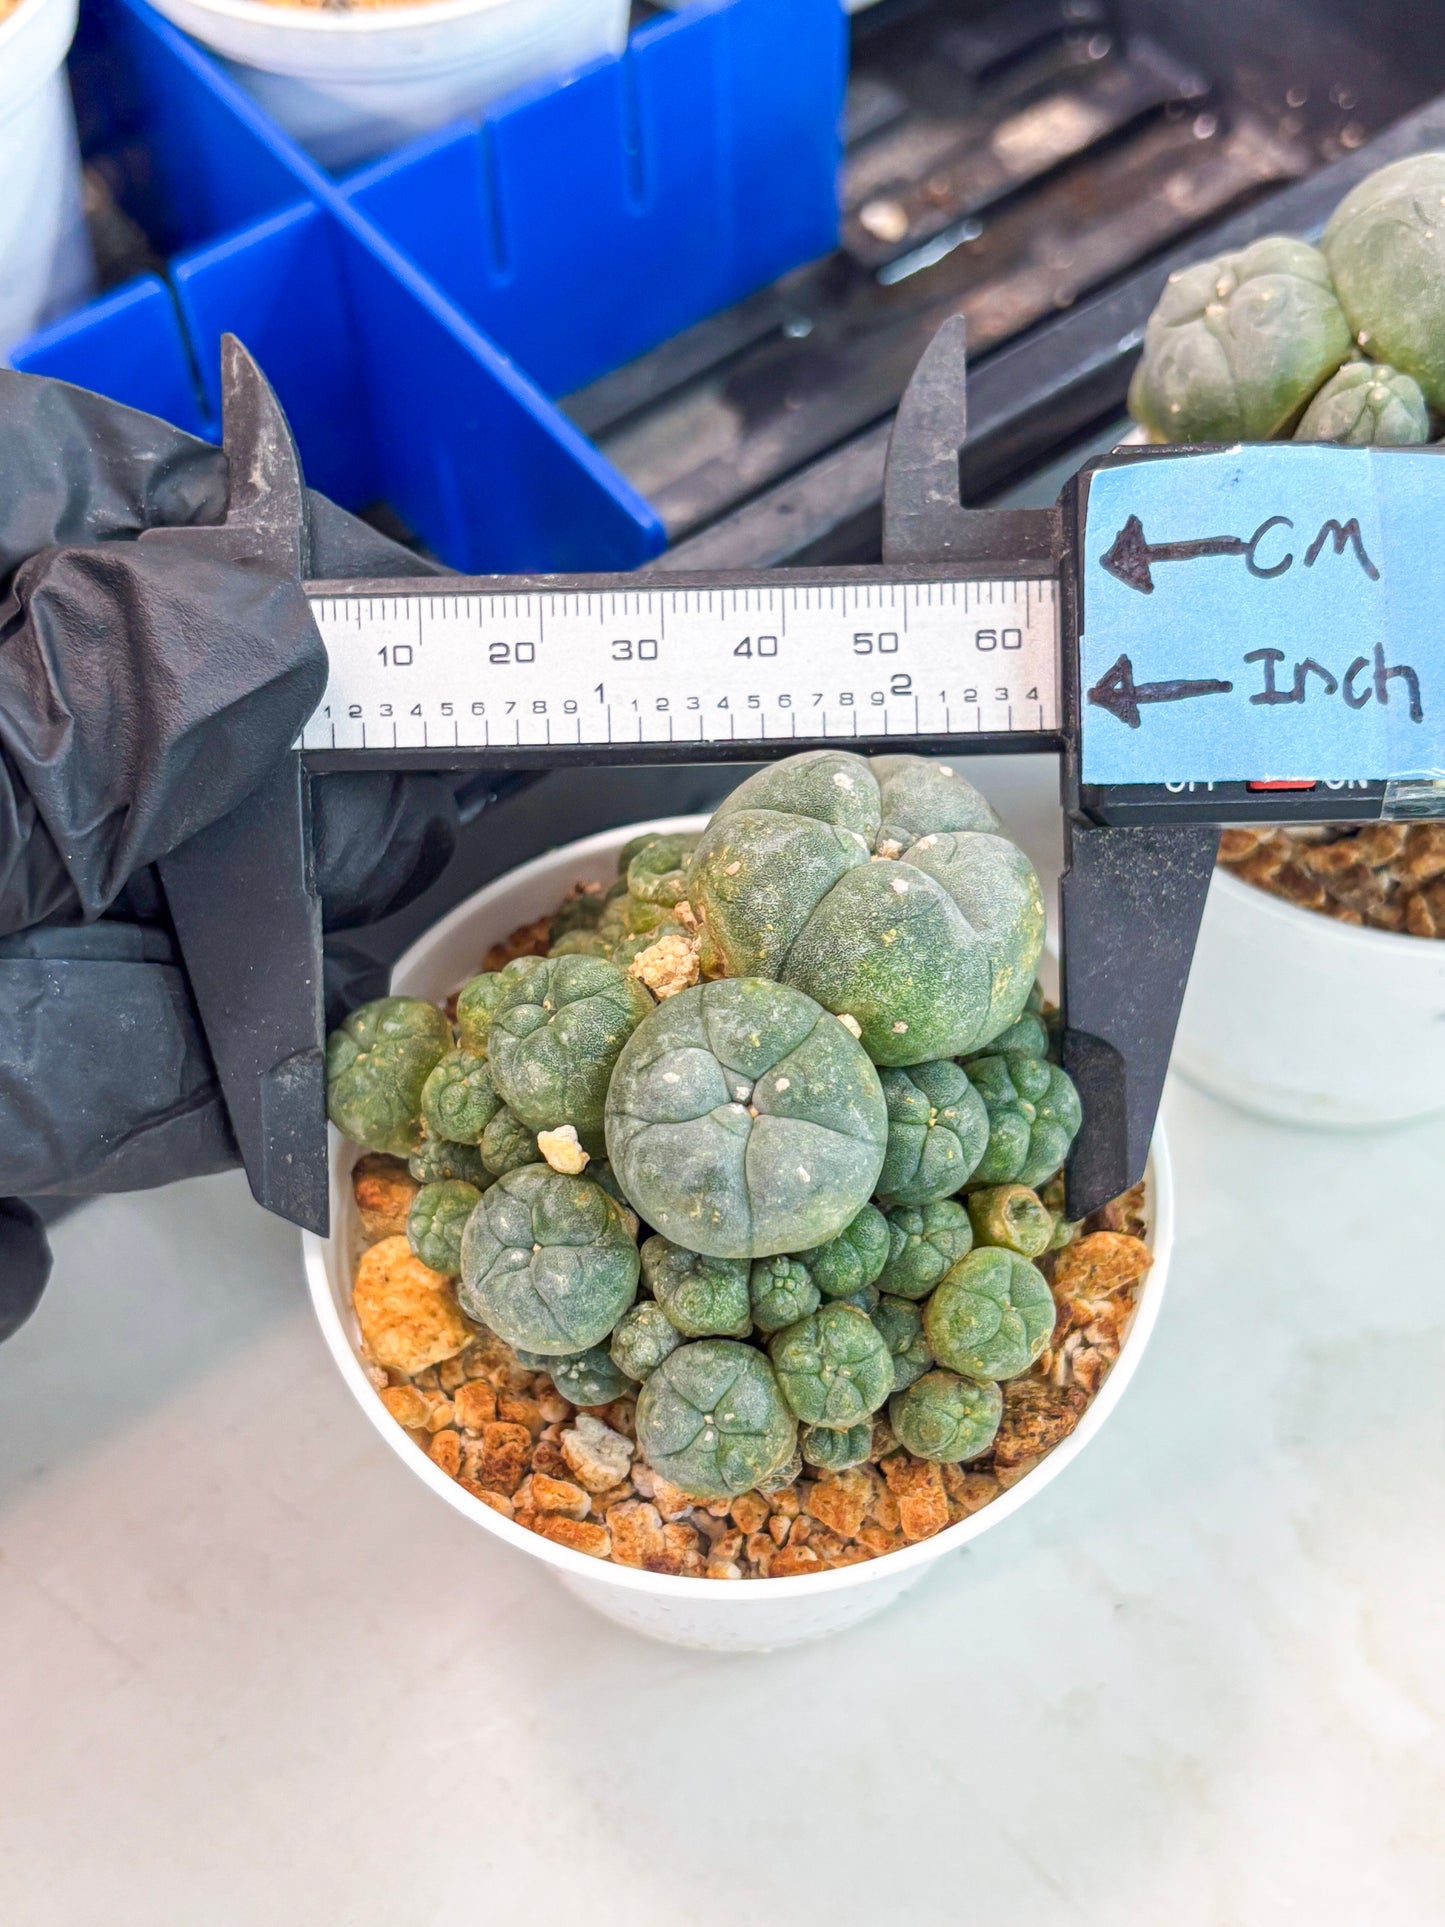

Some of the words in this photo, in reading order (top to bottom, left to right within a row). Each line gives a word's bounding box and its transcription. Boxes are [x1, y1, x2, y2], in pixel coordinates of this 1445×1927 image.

[379, 646, 412, 666] 10
[489, 643, 534, 664] 20
[613, 640, 657, 660] 30
[734, 636, 777, 658] 40
[854, 633, 898, 654] 50
[976, 629, 1022, 651] 60
[349, 705, 362, 718] 2
[381, 704, 393, 716] 3
[411, 704, 421, 716] 4
[441, 703, 453, 716] 5
[472, 703, 484, 715] 6
[505, 702, 516, 714] 7
[533, 701, 546, 713] 8
[564, 700, 577, 713] 9
[595, 683, 603, 703] 1
[657, 698, 668, 711] 2
[688, 697, 699, 709] 3
[718, 697, 728, 708] 4
[749, 696, 759, 708] 5
[779, 695, 791, 707] 6
[812, 694, 822, 706] 7
[840, 693, 853, 705] 8
[872, 692, 884, 705] 9
[891, 674, 912, 695] 2
[965, 689, 977, 702] 2
[996, 688, 1008, 700] 3
[1026, 687, 1038, 700] 4
[1244, 642, 1423, 723] Inch
